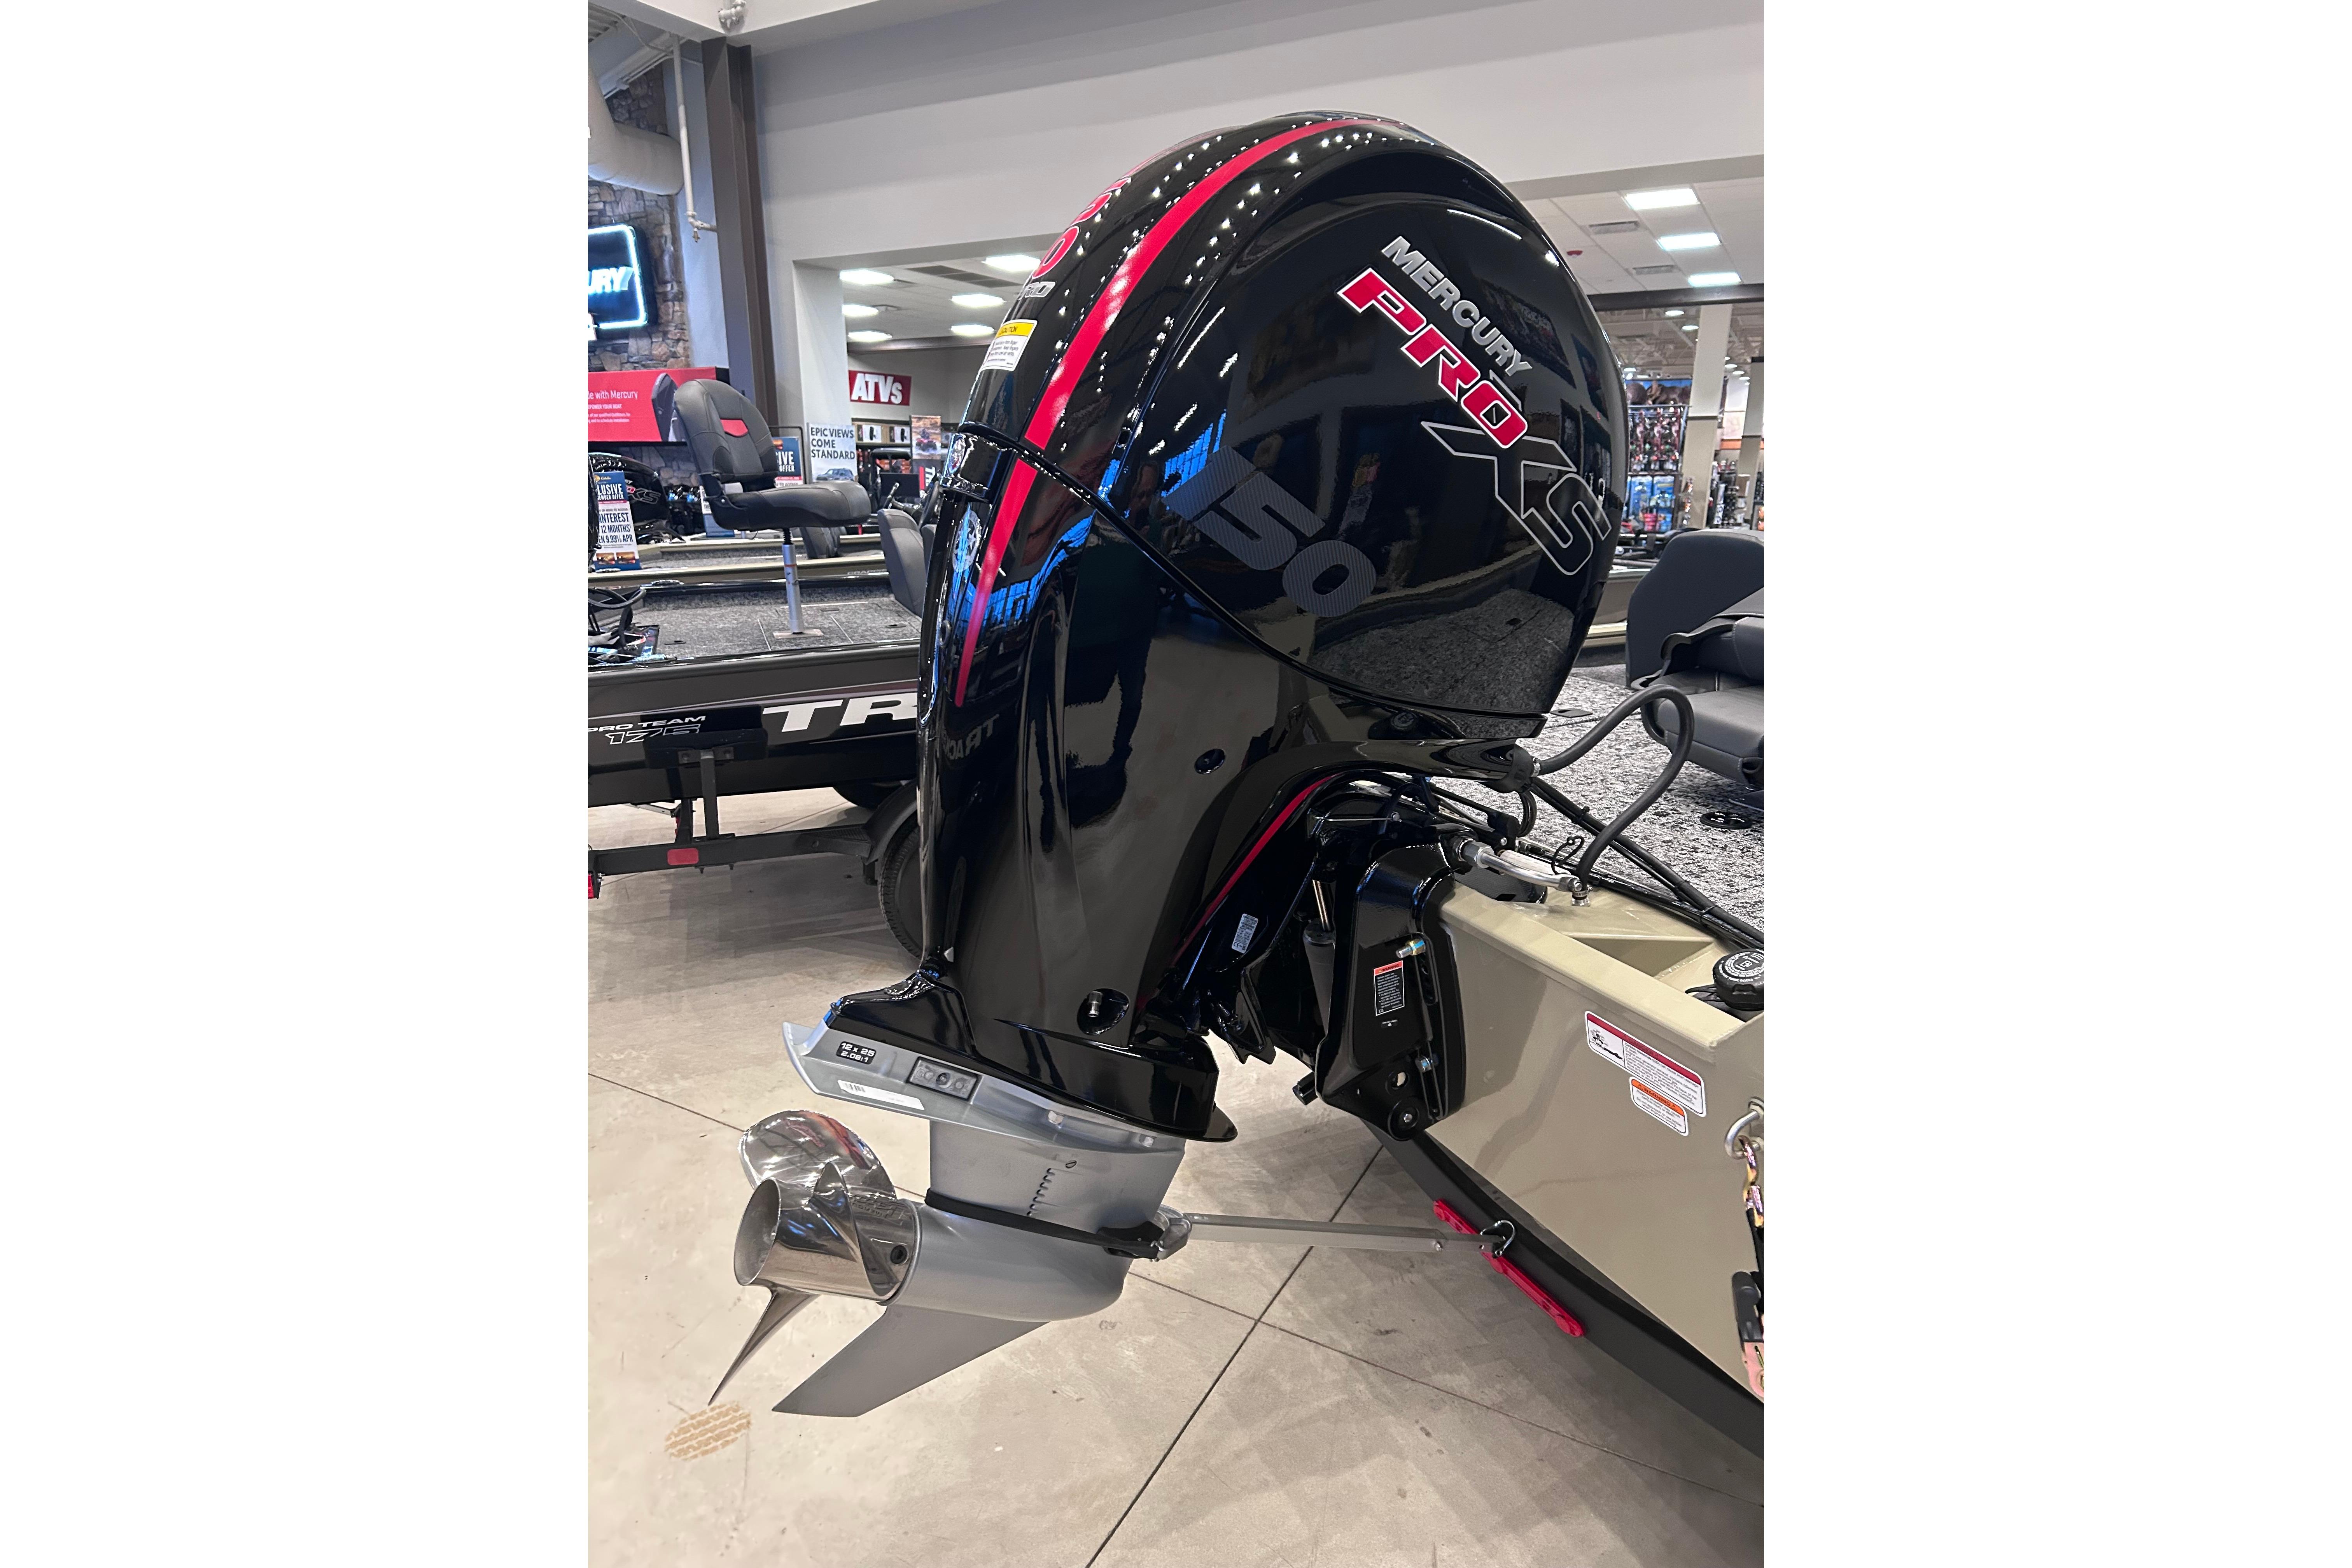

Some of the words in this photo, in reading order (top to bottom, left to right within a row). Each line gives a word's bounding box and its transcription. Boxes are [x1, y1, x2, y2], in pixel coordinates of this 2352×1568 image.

[1382, 236, 1532, 377] MERCURY
[1337, 267, 1528, 449] PRO
[595, 390, 609, 399] with
[610, 390, 638, 399] Mercury
[851, 373, 903, 404] ATVs
[811, 427, 830, 438] EPIC
[830, 428, 854, 438] VIEWS
[811, 438, 836, 448] COME
[777, 451, 794, 465] IVE
[811, 450, 855, 460] STANDARD
[1421, 370, 1612, 576] XS
[597, 483, 623, 495] LUSIVE
[599, 513, 629, 523] INTEREST
[601, 525, 607, 534] 12
[1162, 445, 1377, 617] 150
[606, 534, 622, 543] 9.99%
[623, 534, 634, 542] APR
[638, 716, 706, 728] TEAM
[841, 1043, 853, 1051] 12
[860, 1048, 875, 1057] 25
[841, 1051, 869, 1062] 2.08:1
[1644, 1088, 1671, 1106] WARNING
